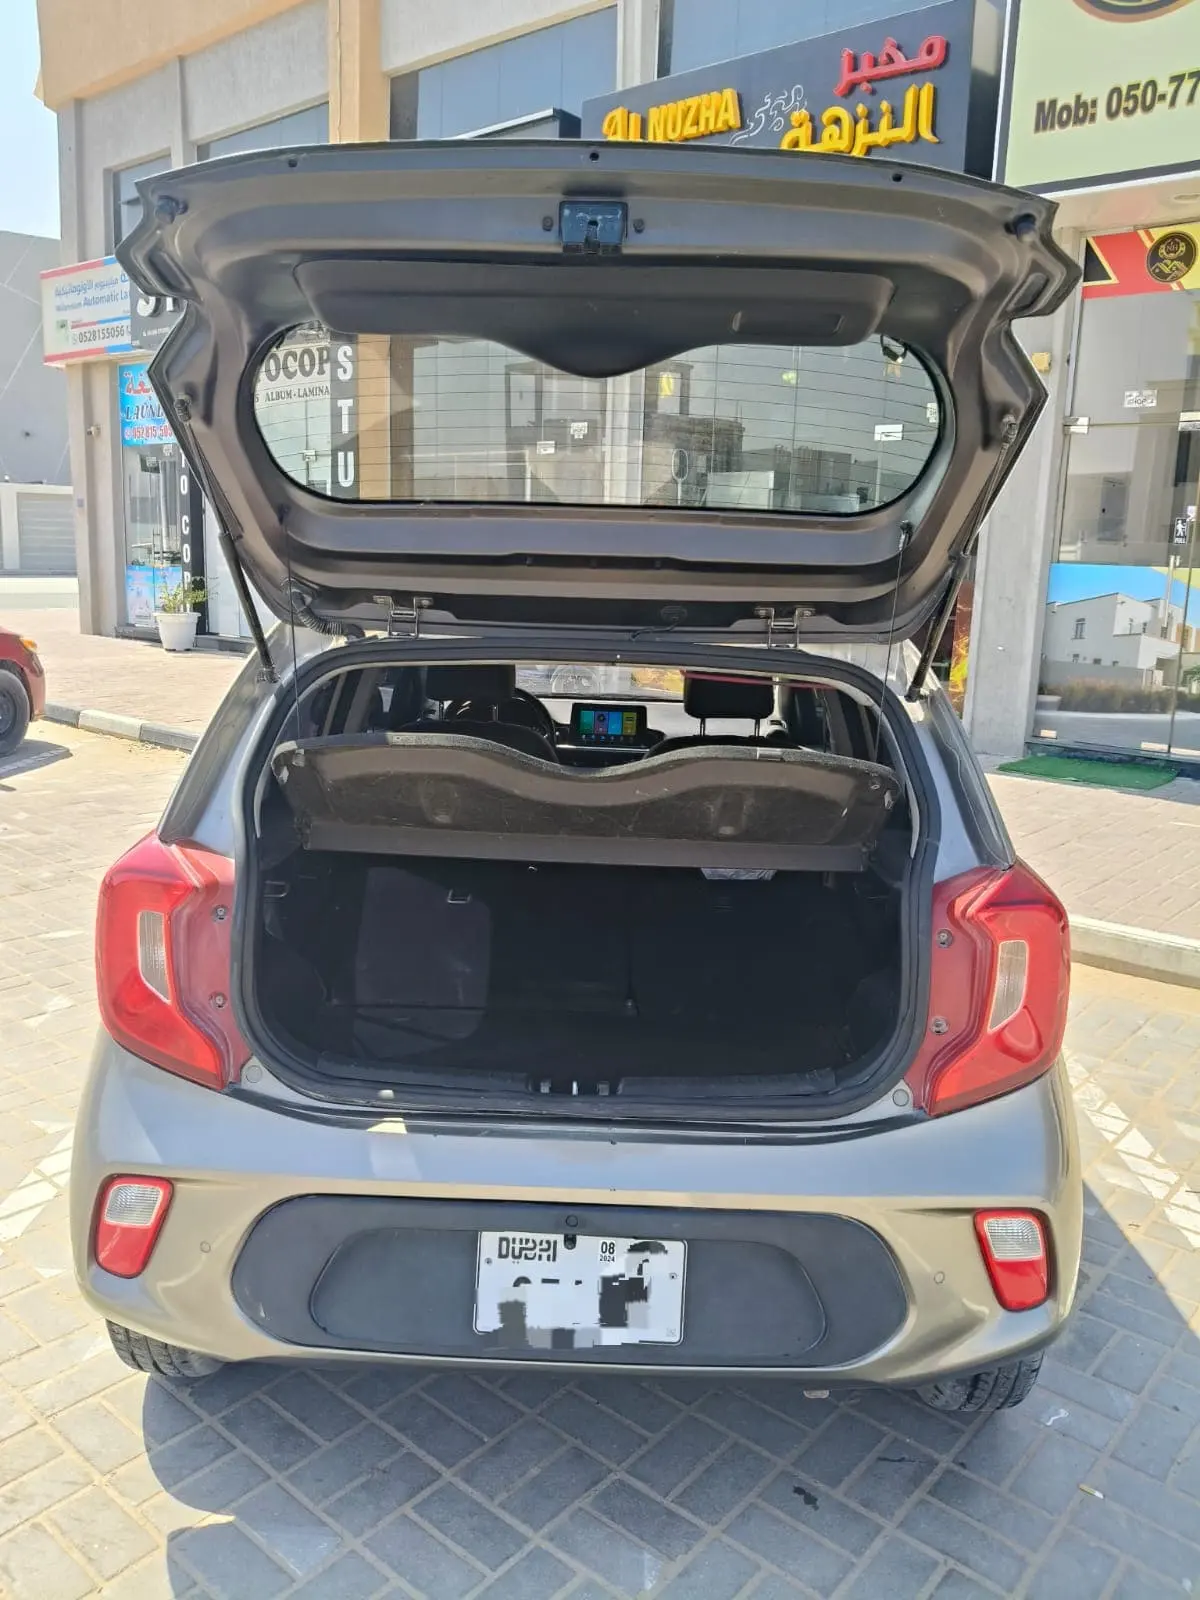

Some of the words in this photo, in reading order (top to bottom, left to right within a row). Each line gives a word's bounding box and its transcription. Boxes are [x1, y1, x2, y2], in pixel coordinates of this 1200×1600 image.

[833, 34, 948, 97] مخبز
[648, 87, 741, 141] NUZHA
[781, 82, 940, 156] النزهة
[1034, 93, 1098, 134] Mob:
[1106, 69, 1200, 121] 050-77
[83, 289, 119, 306] Automatic
[78, 325, 125, 343] 0528155056
[265, 346, 330, 381] OCOP
[181, 515, 191, 613] COP
[497, 1236, 557, 1262] DUBAI
[601, 1241, 615, 1255] 08
